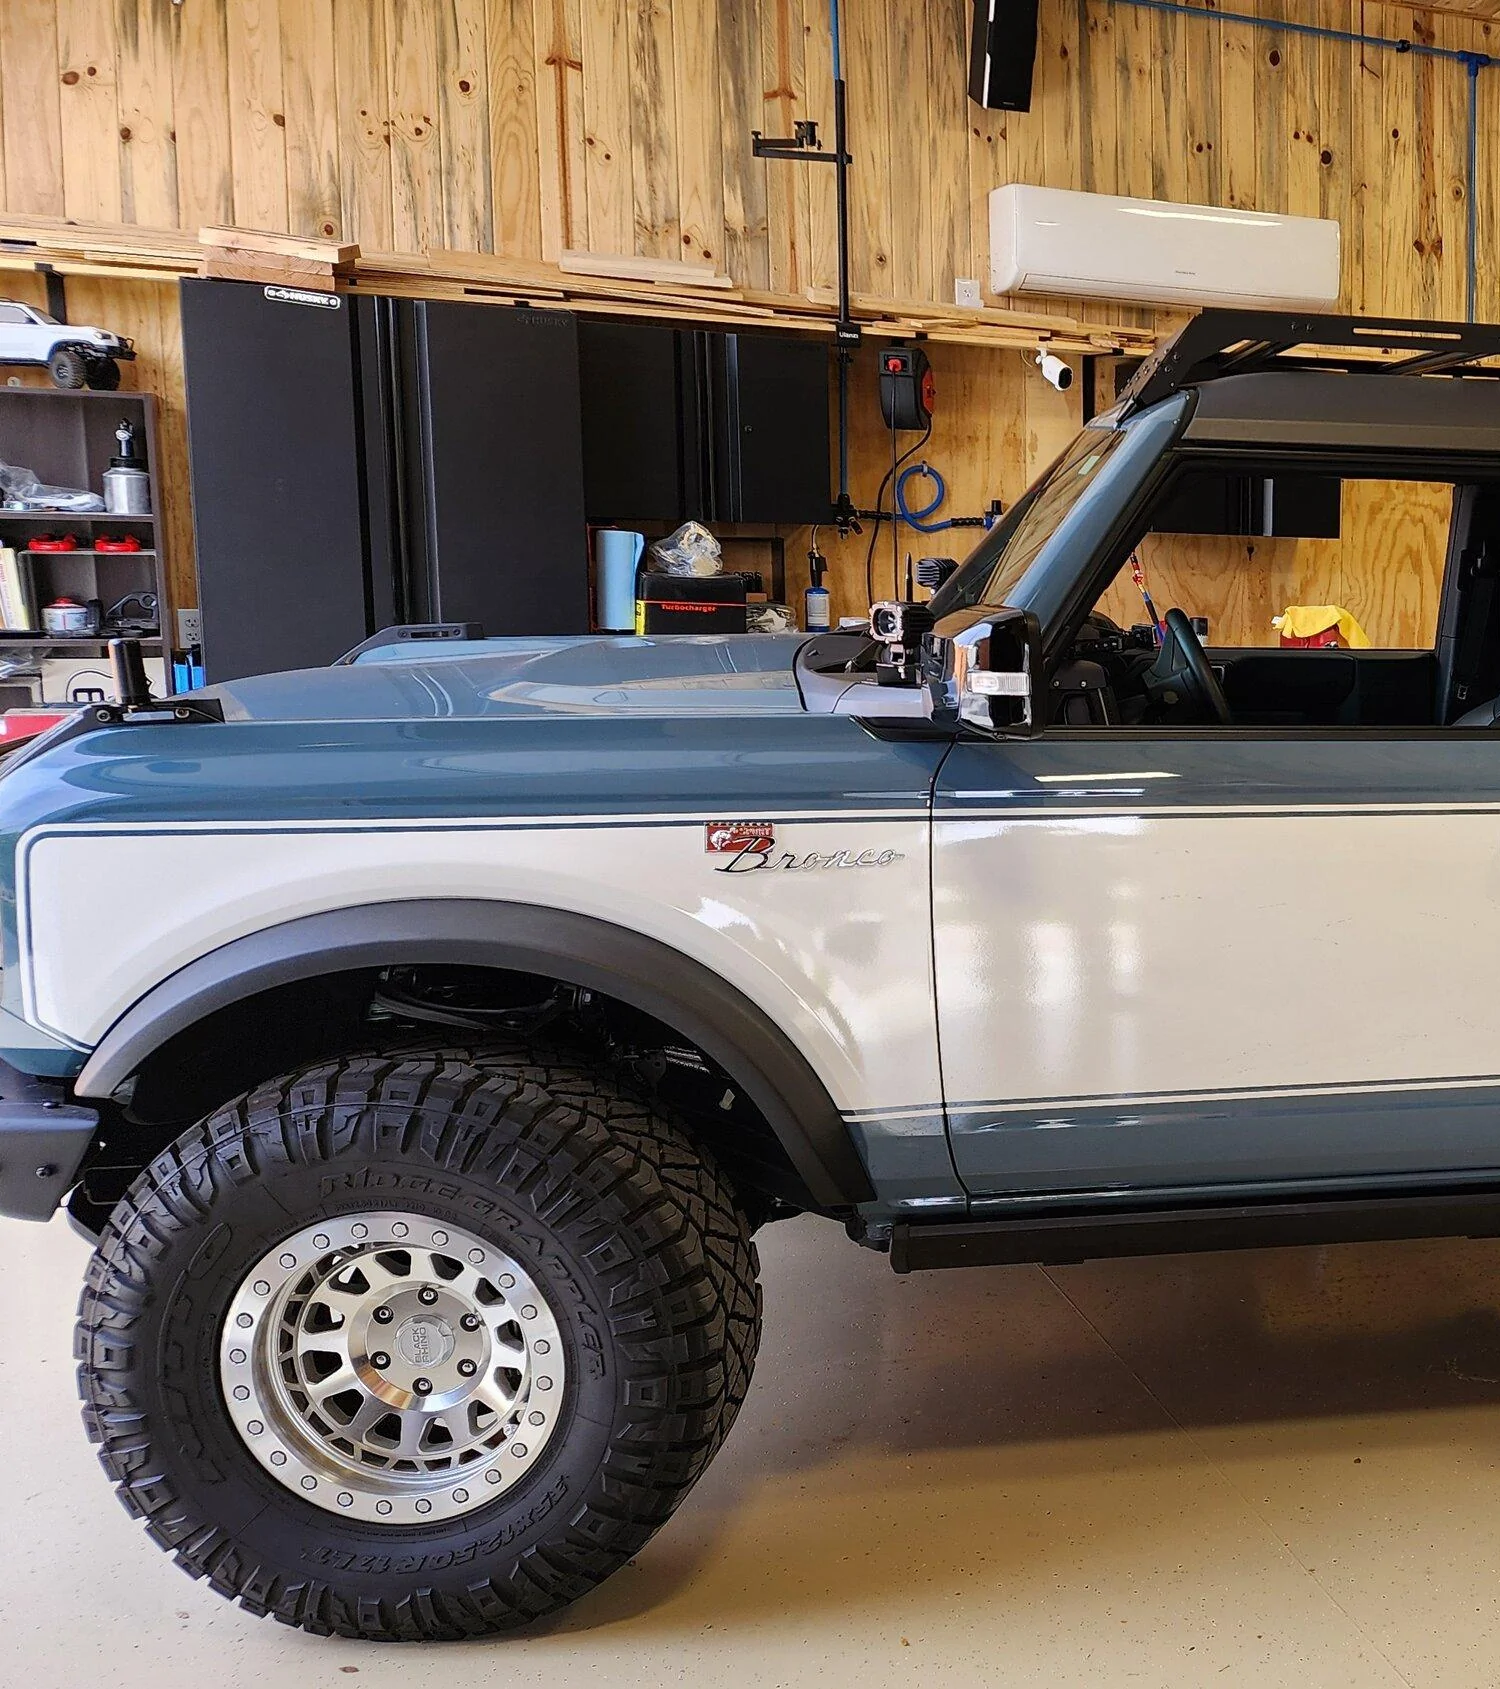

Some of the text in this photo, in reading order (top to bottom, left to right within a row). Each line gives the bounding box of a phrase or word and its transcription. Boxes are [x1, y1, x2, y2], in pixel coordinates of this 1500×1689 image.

[661, 604, 717, 612] Turbocharger
[714, 836, 905, 873] Bronco
[412, 1327, 421, 1363] BLACK
[420, 1326, 430, 1363] RHINO
